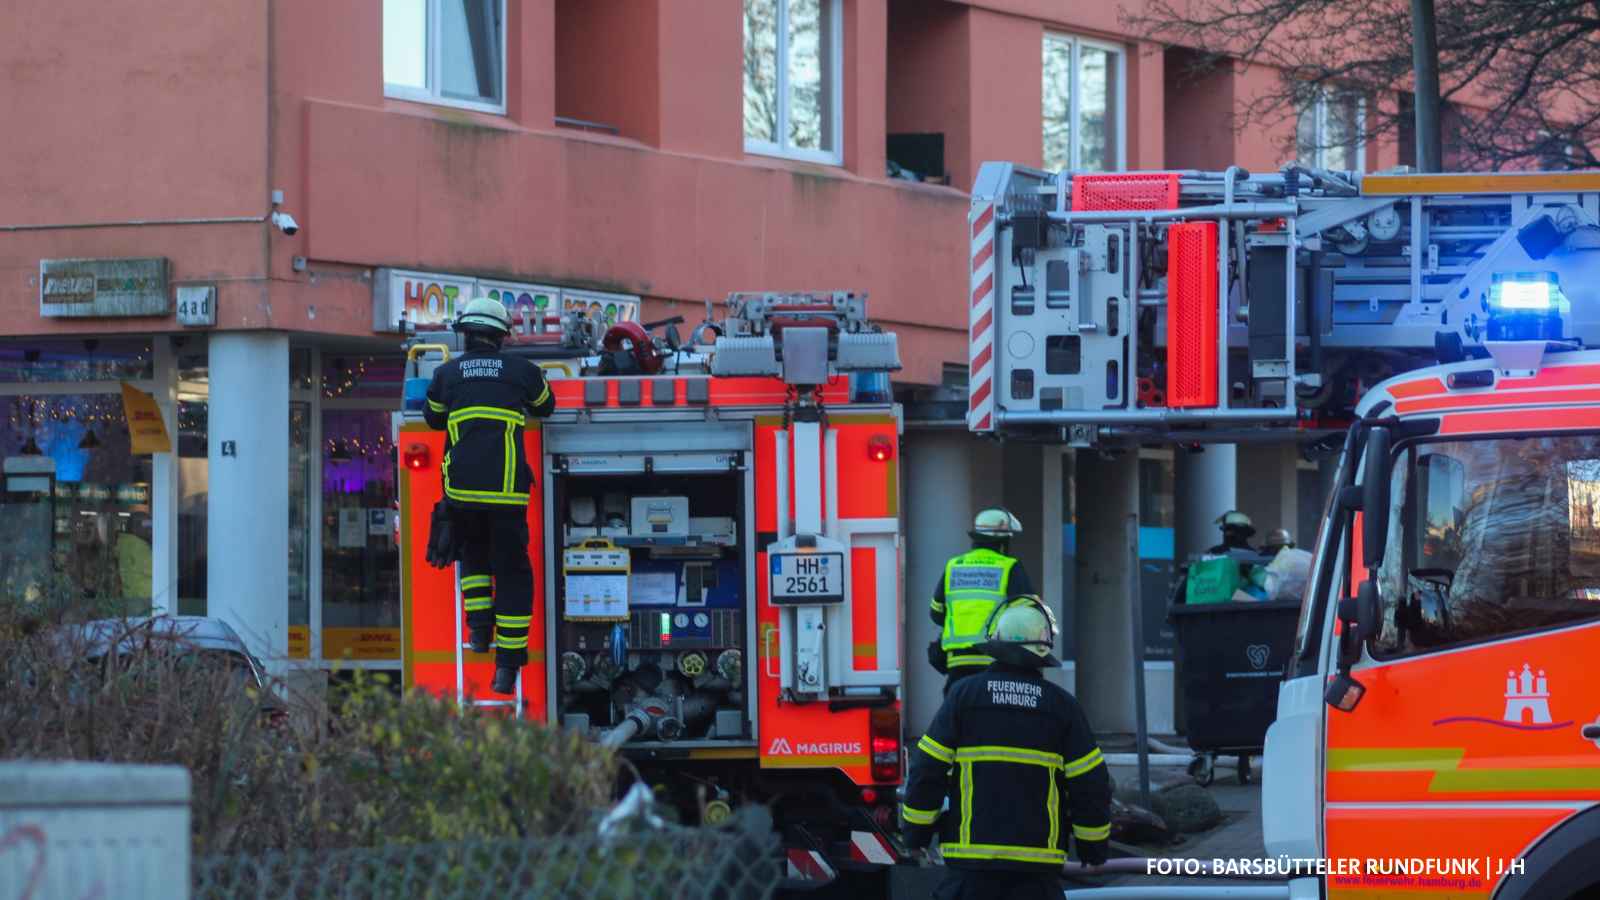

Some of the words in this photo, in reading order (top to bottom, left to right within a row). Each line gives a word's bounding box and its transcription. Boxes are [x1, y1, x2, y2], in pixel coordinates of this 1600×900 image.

[405, 281, 459, 325] HOT
[459, 358, 503, 370] FEUERWEHR
[463, 368, 499, 378] HAMBURG
[224, 441, 232, 455] 4
[796, 558, 819, 575] HH
[786, 576, 829, 593] 2561
[988, 680, 1042, 697] FEUERWEHR
[993, 692, 1037, 708] HAMBURG
[797, 742, 861, 754] MAGIRUS
[1335, 875, 1482, 890] www.feuerwehr.hamburg.de
